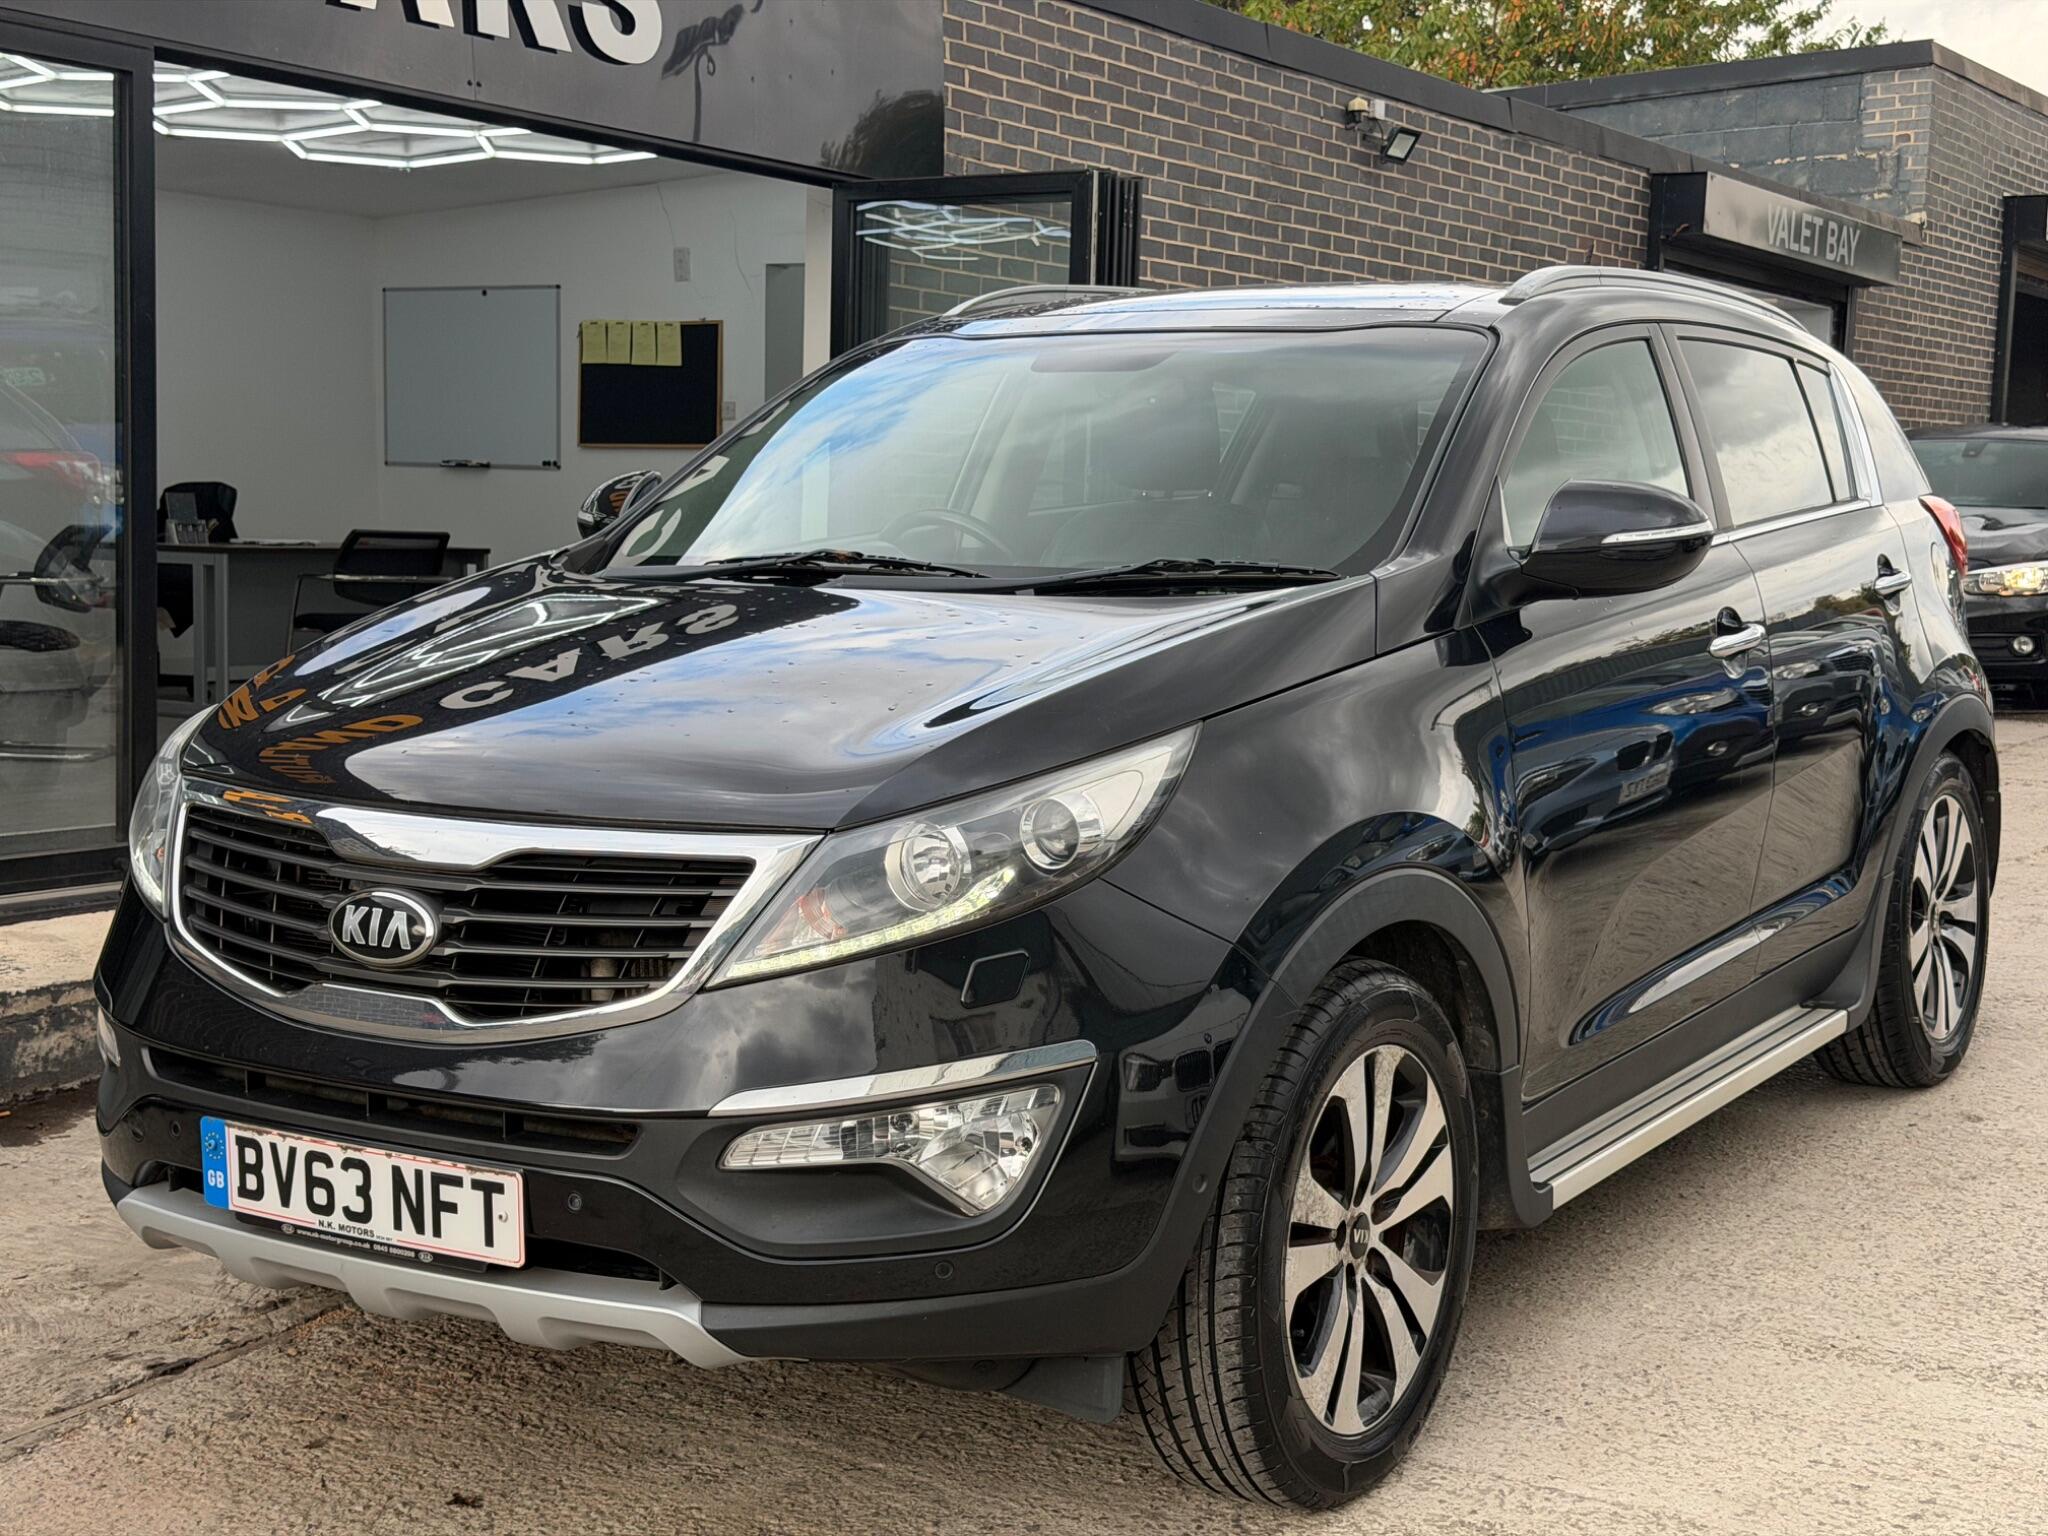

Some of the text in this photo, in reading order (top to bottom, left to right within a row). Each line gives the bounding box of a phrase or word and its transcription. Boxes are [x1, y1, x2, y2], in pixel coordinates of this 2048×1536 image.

[1767, 203, 1861, 267] VALET BAY
[342, 904, 412, 951] KIA
[207, 1169, 225, 1189] GB
[235, 1134, 506, 1249] BV63 NFT
[317, 1219, 336, 1231] N.K.
[338, 1223, 375, 1239] MOTORS
